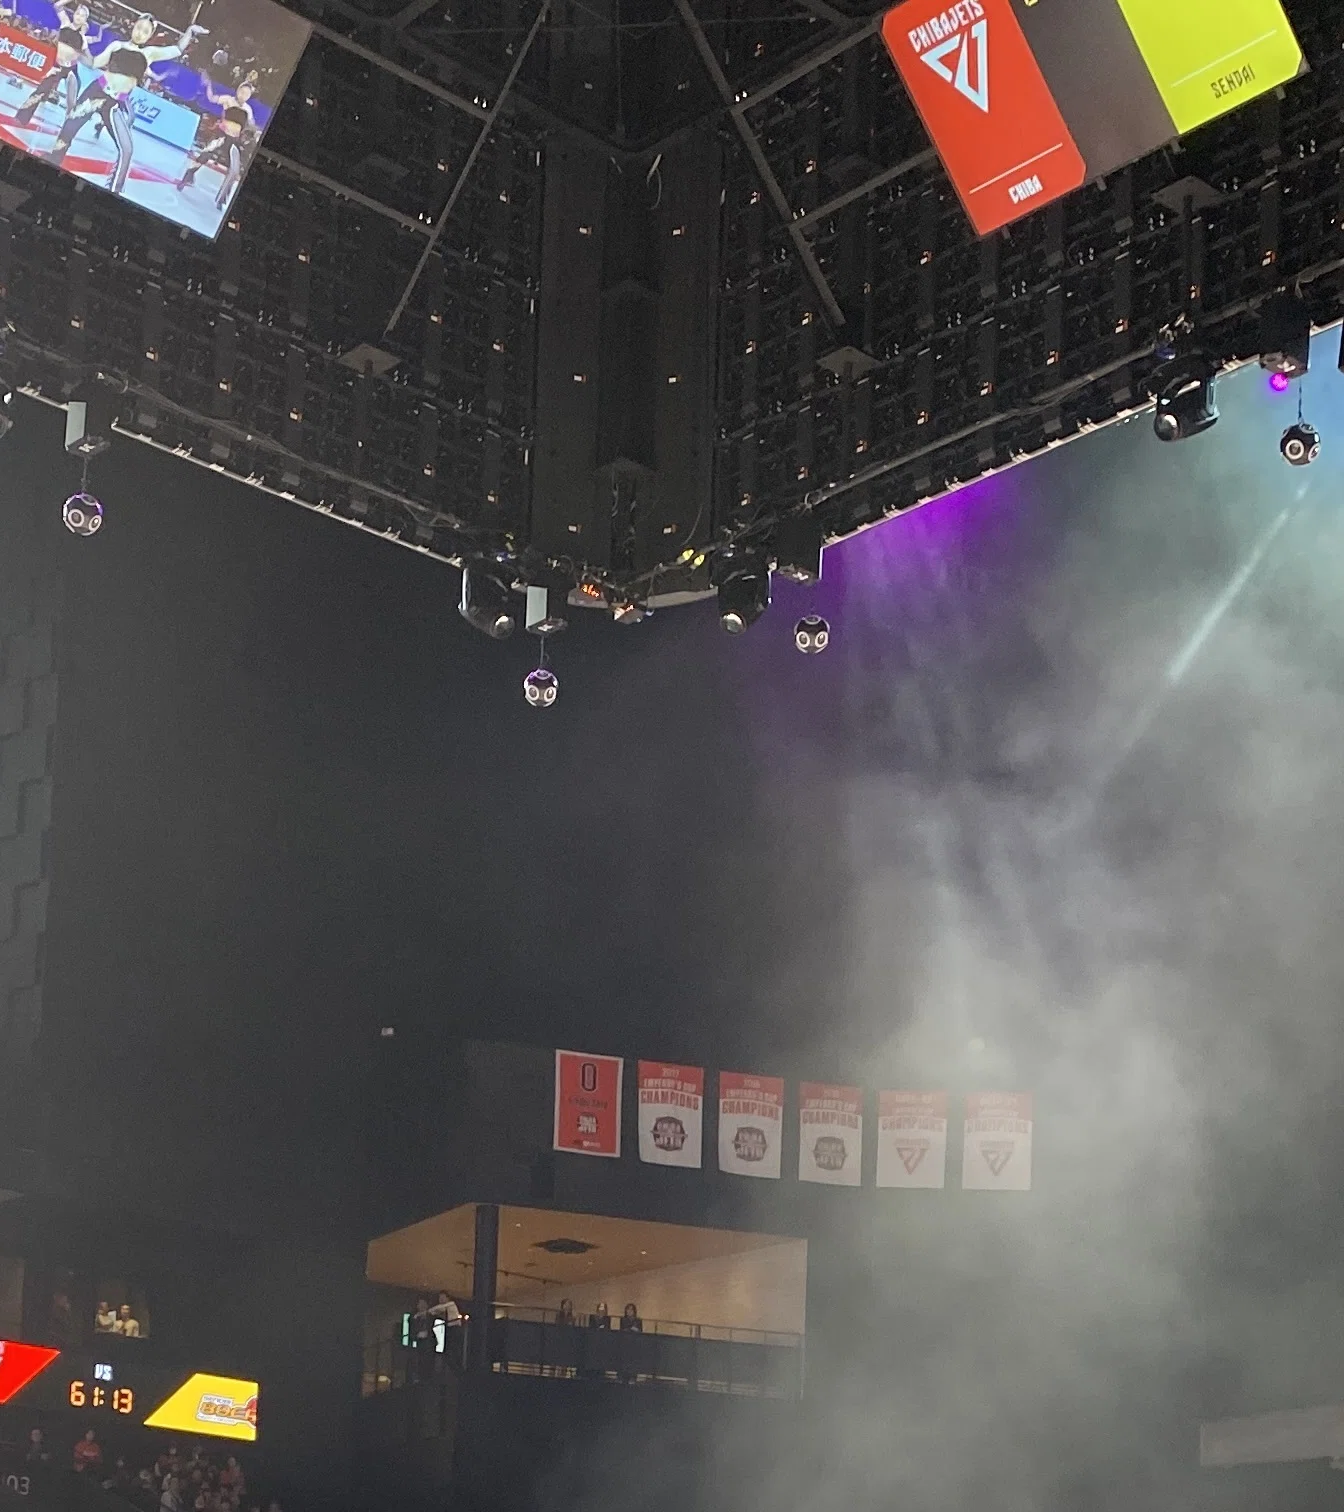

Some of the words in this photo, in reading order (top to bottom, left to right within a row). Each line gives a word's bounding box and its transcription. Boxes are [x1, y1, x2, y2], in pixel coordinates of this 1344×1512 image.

[1210, 62, 1255, 98] SENDAI
[1008, 174, 1043, 204] CHIBA
[641, 1090, 699, 1110] CHAMPIONS
[94, 1363, 113, 1381] VS
[70, 1380, 133, 1414] 61:13
